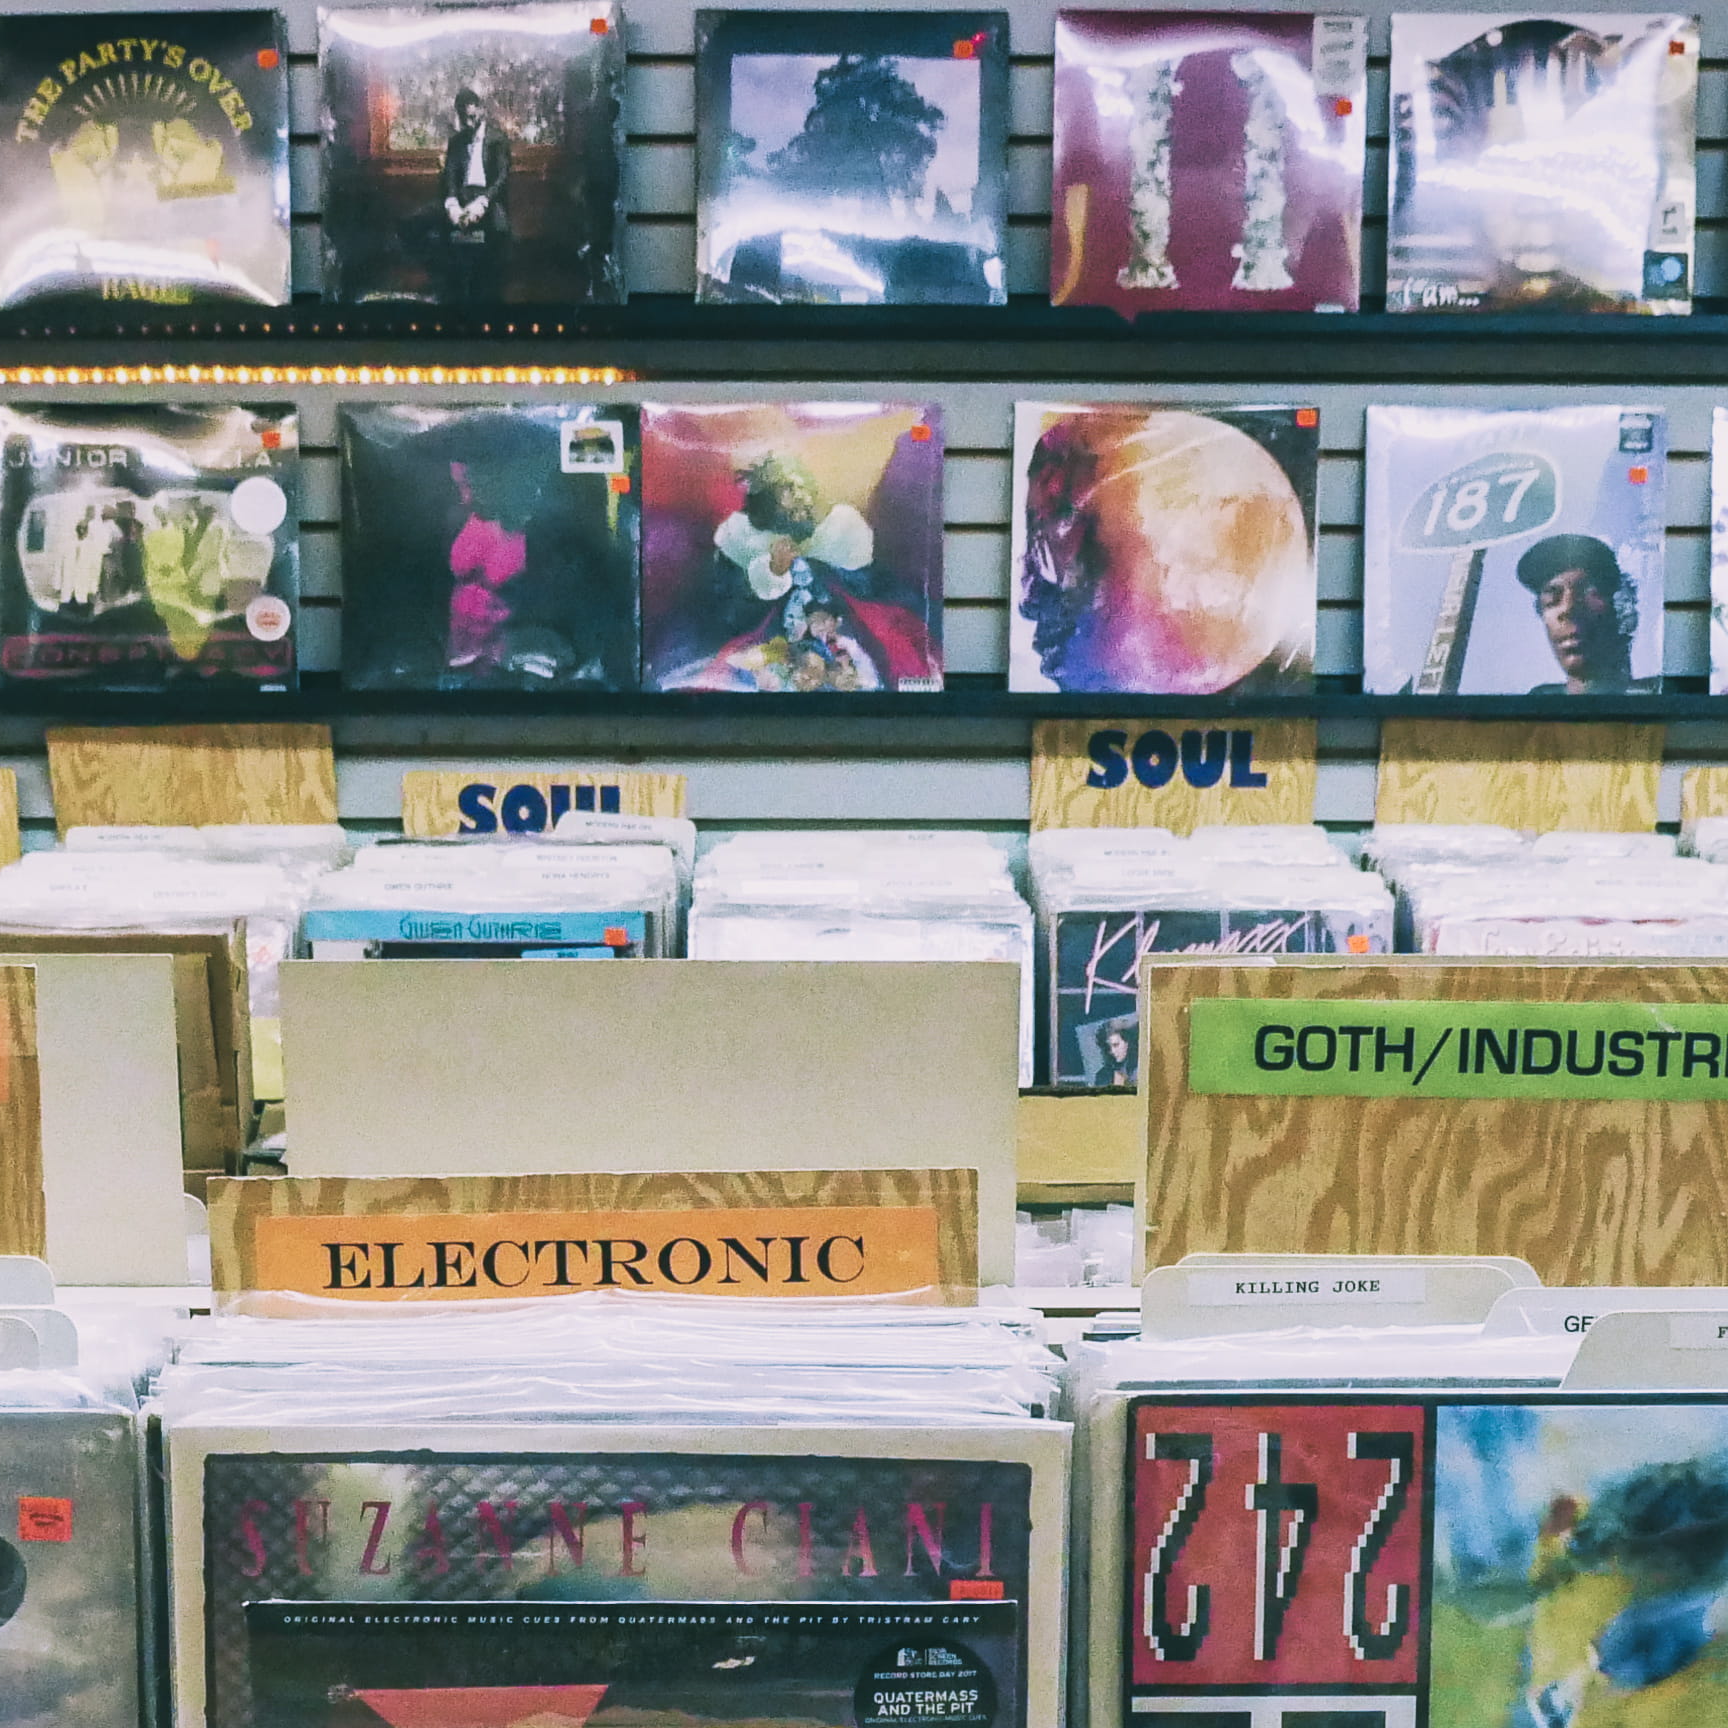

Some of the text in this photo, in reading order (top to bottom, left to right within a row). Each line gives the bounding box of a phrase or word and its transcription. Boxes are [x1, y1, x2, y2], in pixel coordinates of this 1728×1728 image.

[15, 36, 254, 143] THE PARTY'S OVER
[1423, 468, 1541, 537] 187
[1086, 729, 1268, 789] SOUL
[322, 1234, 866, 1291] ELECTRONIC
[1235, 1279, 1380, 1294] KILLING JOKE
[234, 1500, 998, 1580] SUZANNE CIANI
[873, 1689, 980, 1705] QUATERMASS
[877, 1701, 976, 1717] AND THE PIT
